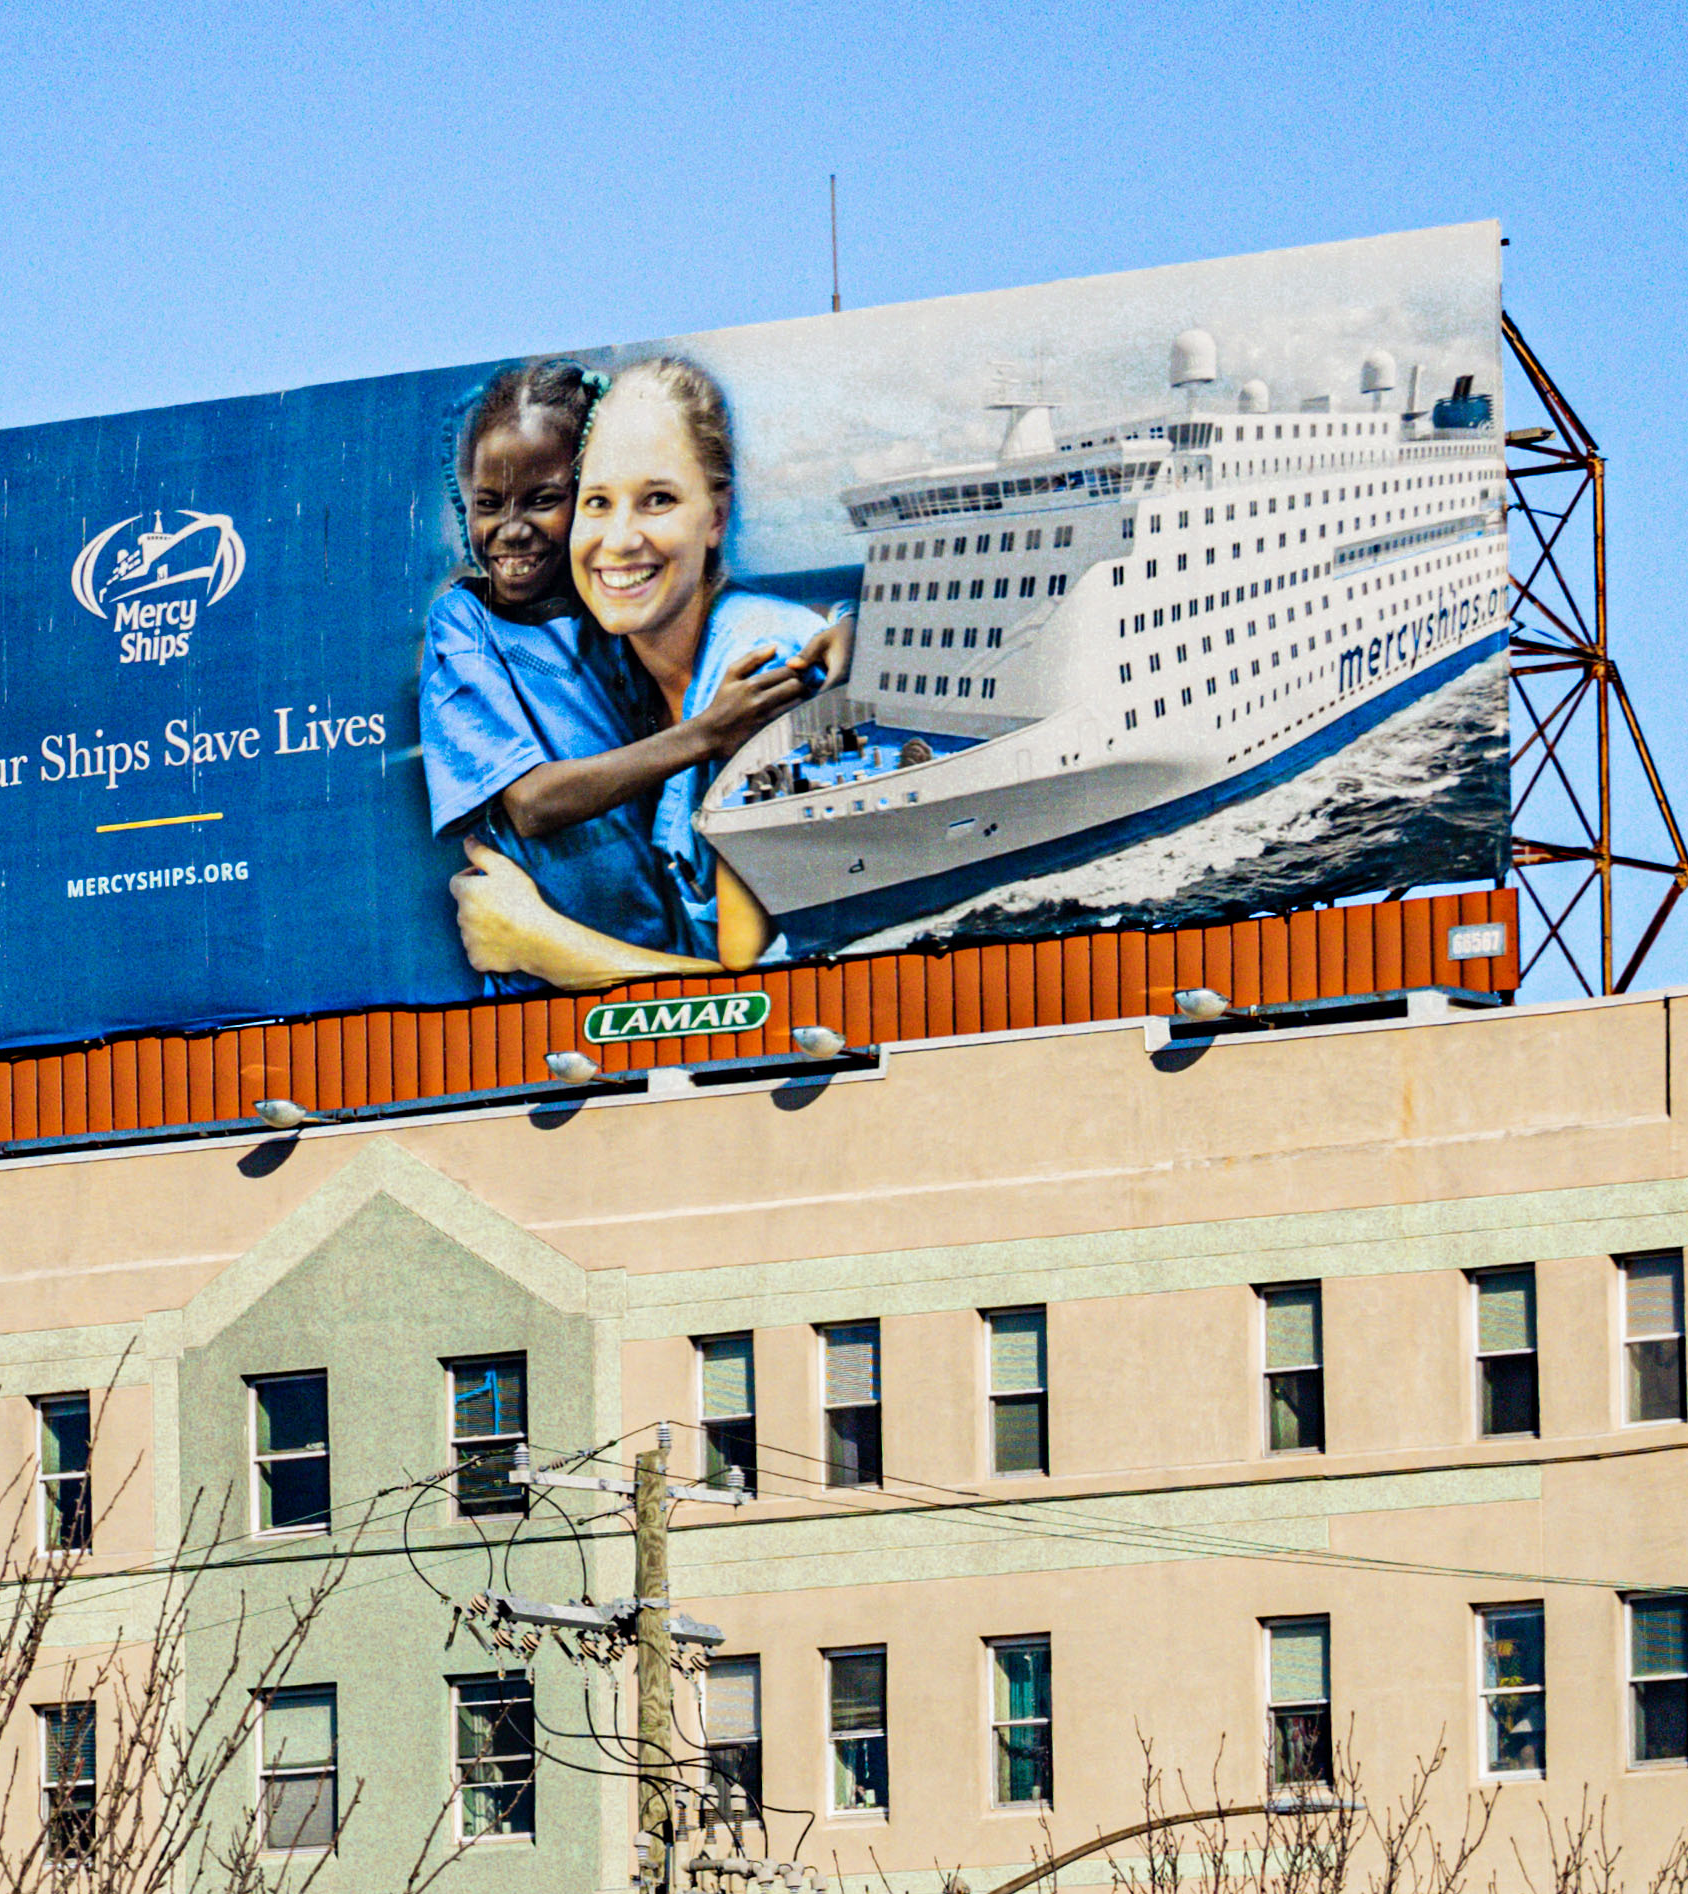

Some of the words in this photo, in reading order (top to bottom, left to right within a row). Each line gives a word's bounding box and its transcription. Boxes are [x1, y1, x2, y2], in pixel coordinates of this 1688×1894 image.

[113, 599, 197, 632] Mercy
[119, 628, 190, 666] Ships
[40, 728, 150, 790] Ships
[164, 719, 260, 767] Save
[274, 704, 387, 756] Lives
[67, 861, 249, 899] MERCYSHIPS.ORG
[599, 999, 750, 1036] LAMAR
